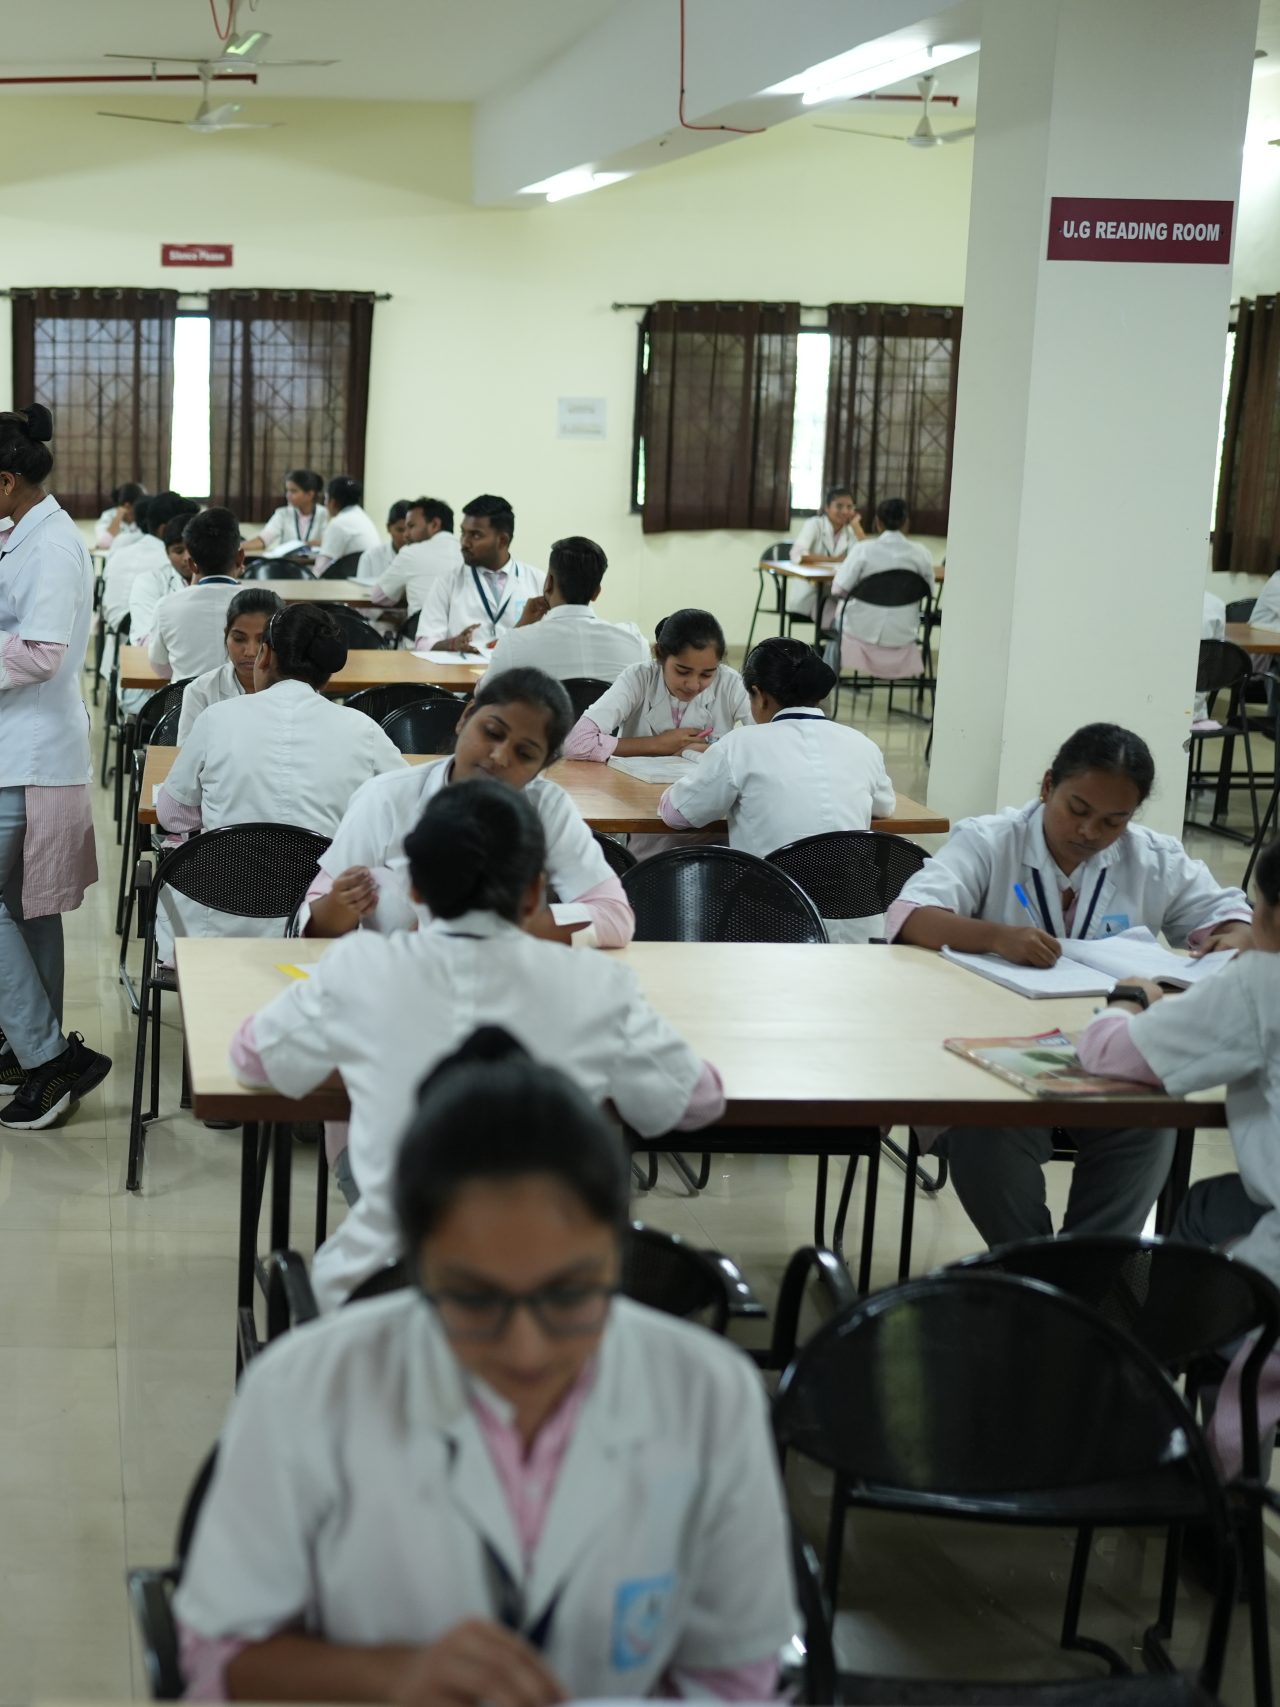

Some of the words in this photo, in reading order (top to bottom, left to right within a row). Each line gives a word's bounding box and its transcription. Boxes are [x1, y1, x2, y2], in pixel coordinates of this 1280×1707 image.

[1063, 220, 1091, 239] U.G
[1095, 221, 1168, 241] READING
[1172, 223, 1220, 242] ROOM
